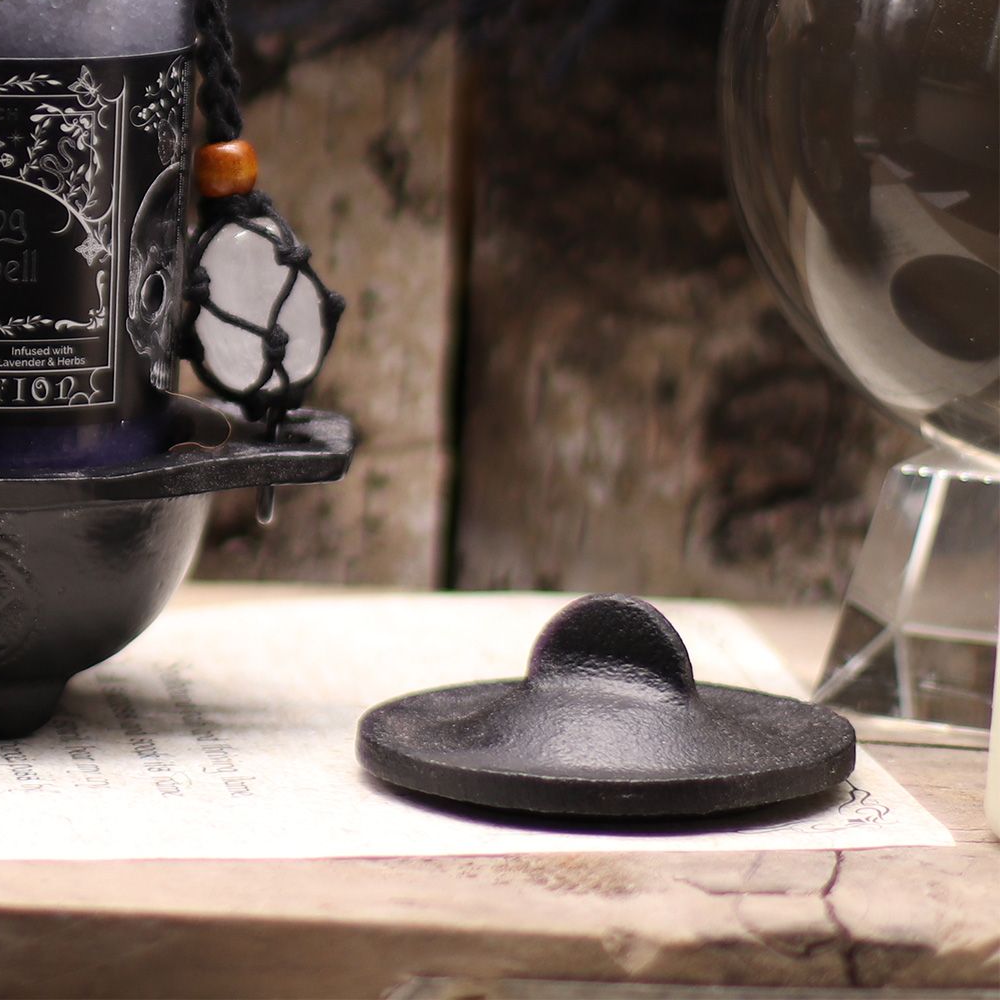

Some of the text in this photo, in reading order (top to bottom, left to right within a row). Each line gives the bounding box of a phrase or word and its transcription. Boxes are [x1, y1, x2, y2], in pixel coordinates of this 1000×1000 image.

[11, 345, 74, 357] Infused with
[47, 356, 55, 367] &
[57, 354, 86, 367] Herbs
